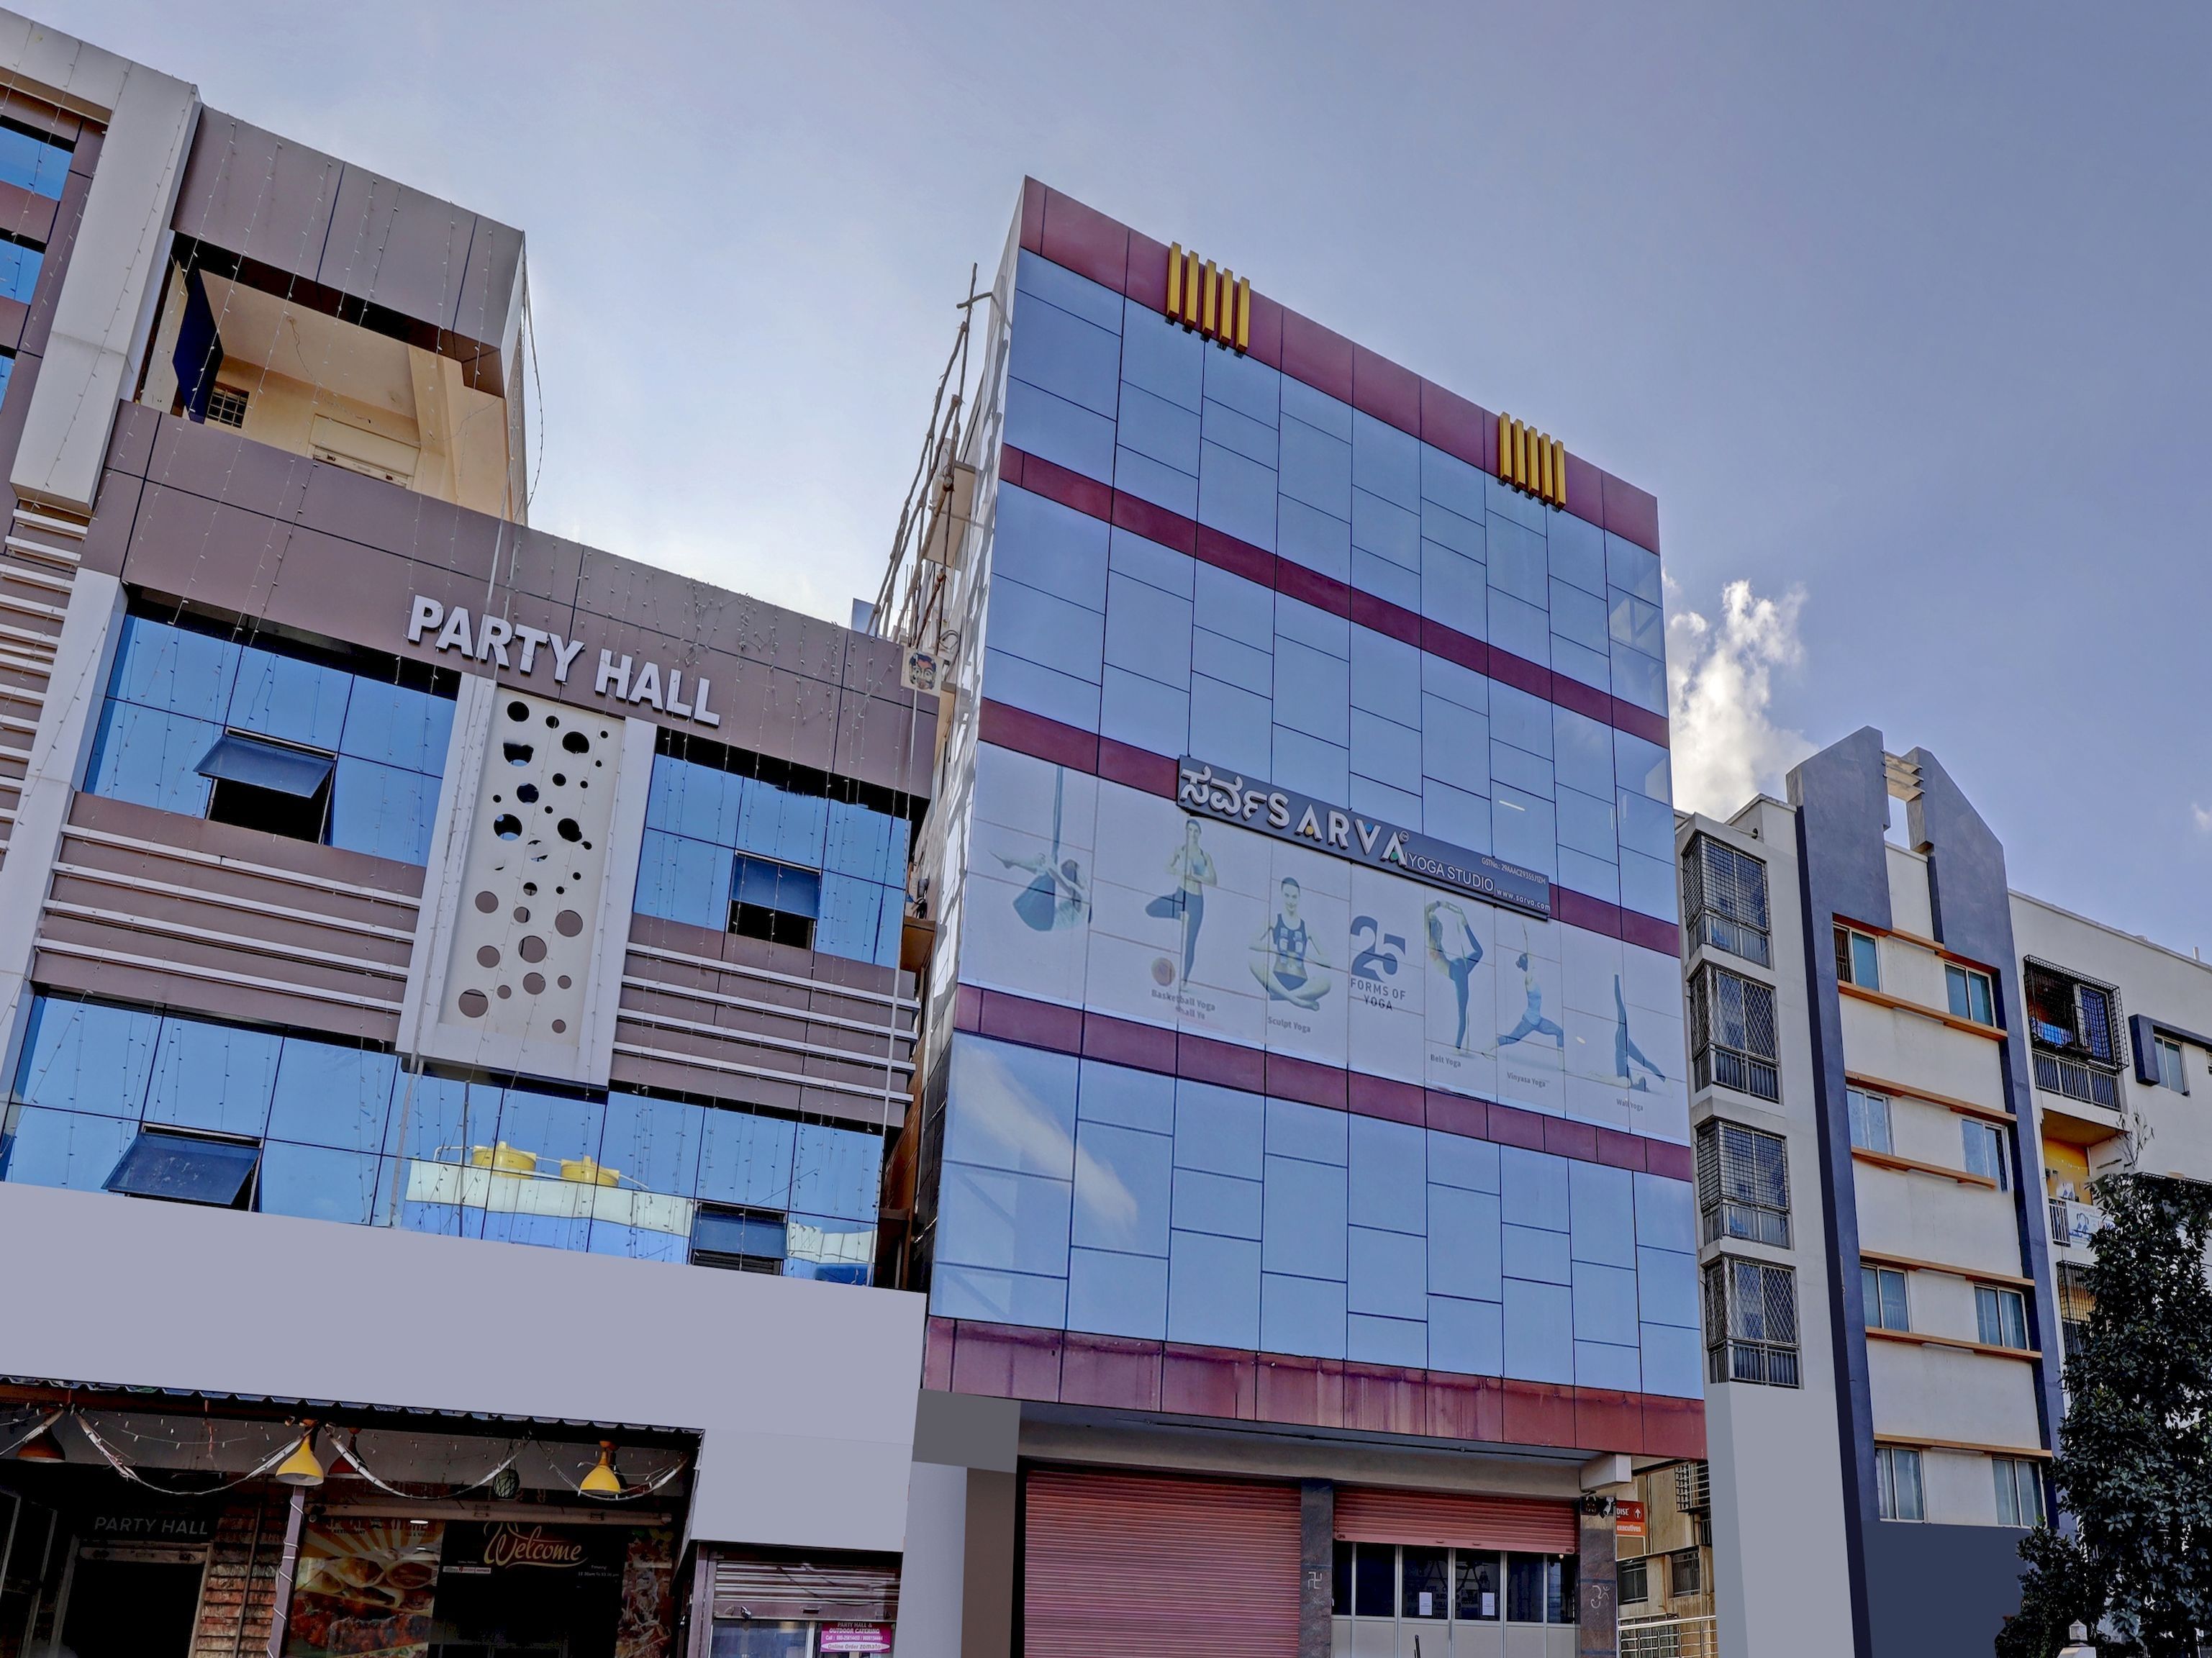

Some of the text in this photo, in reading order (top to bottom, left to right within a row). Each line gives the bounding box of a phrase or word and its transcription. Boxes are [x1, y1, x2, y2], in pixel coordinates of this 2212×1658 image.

[408, 594, 720, 728] PARTY HALL
[1179, 765, 1267, 820] ಸರ್ವ
[1267, 792, 1407, 866] SARVA
[1408, 852, 1494, 892] YOGA STUDIO
[1497, 889, 1551, 911] www.sarva.com
[1350, 915, 1406, 983] 25
[1350, 977, 1406, 1000] FORMS OF
[1151, 989, 1215, 1012] Basketball Yoga
[1364, 995, 1393, 1011] YOGA
[1267, 1016, 1311, 1033] Sculpt Yoga
[1431, 1054, 1461, 1068] Belt Yoga
[1507, 1071, 1546, 1088] Vinyasa Yoga
[1630, 1102, 1644, 1112] Yoga
[94, 1516, 208, 1535] PARTY HALL
[484, 1521, 587, 1567] Welcome
